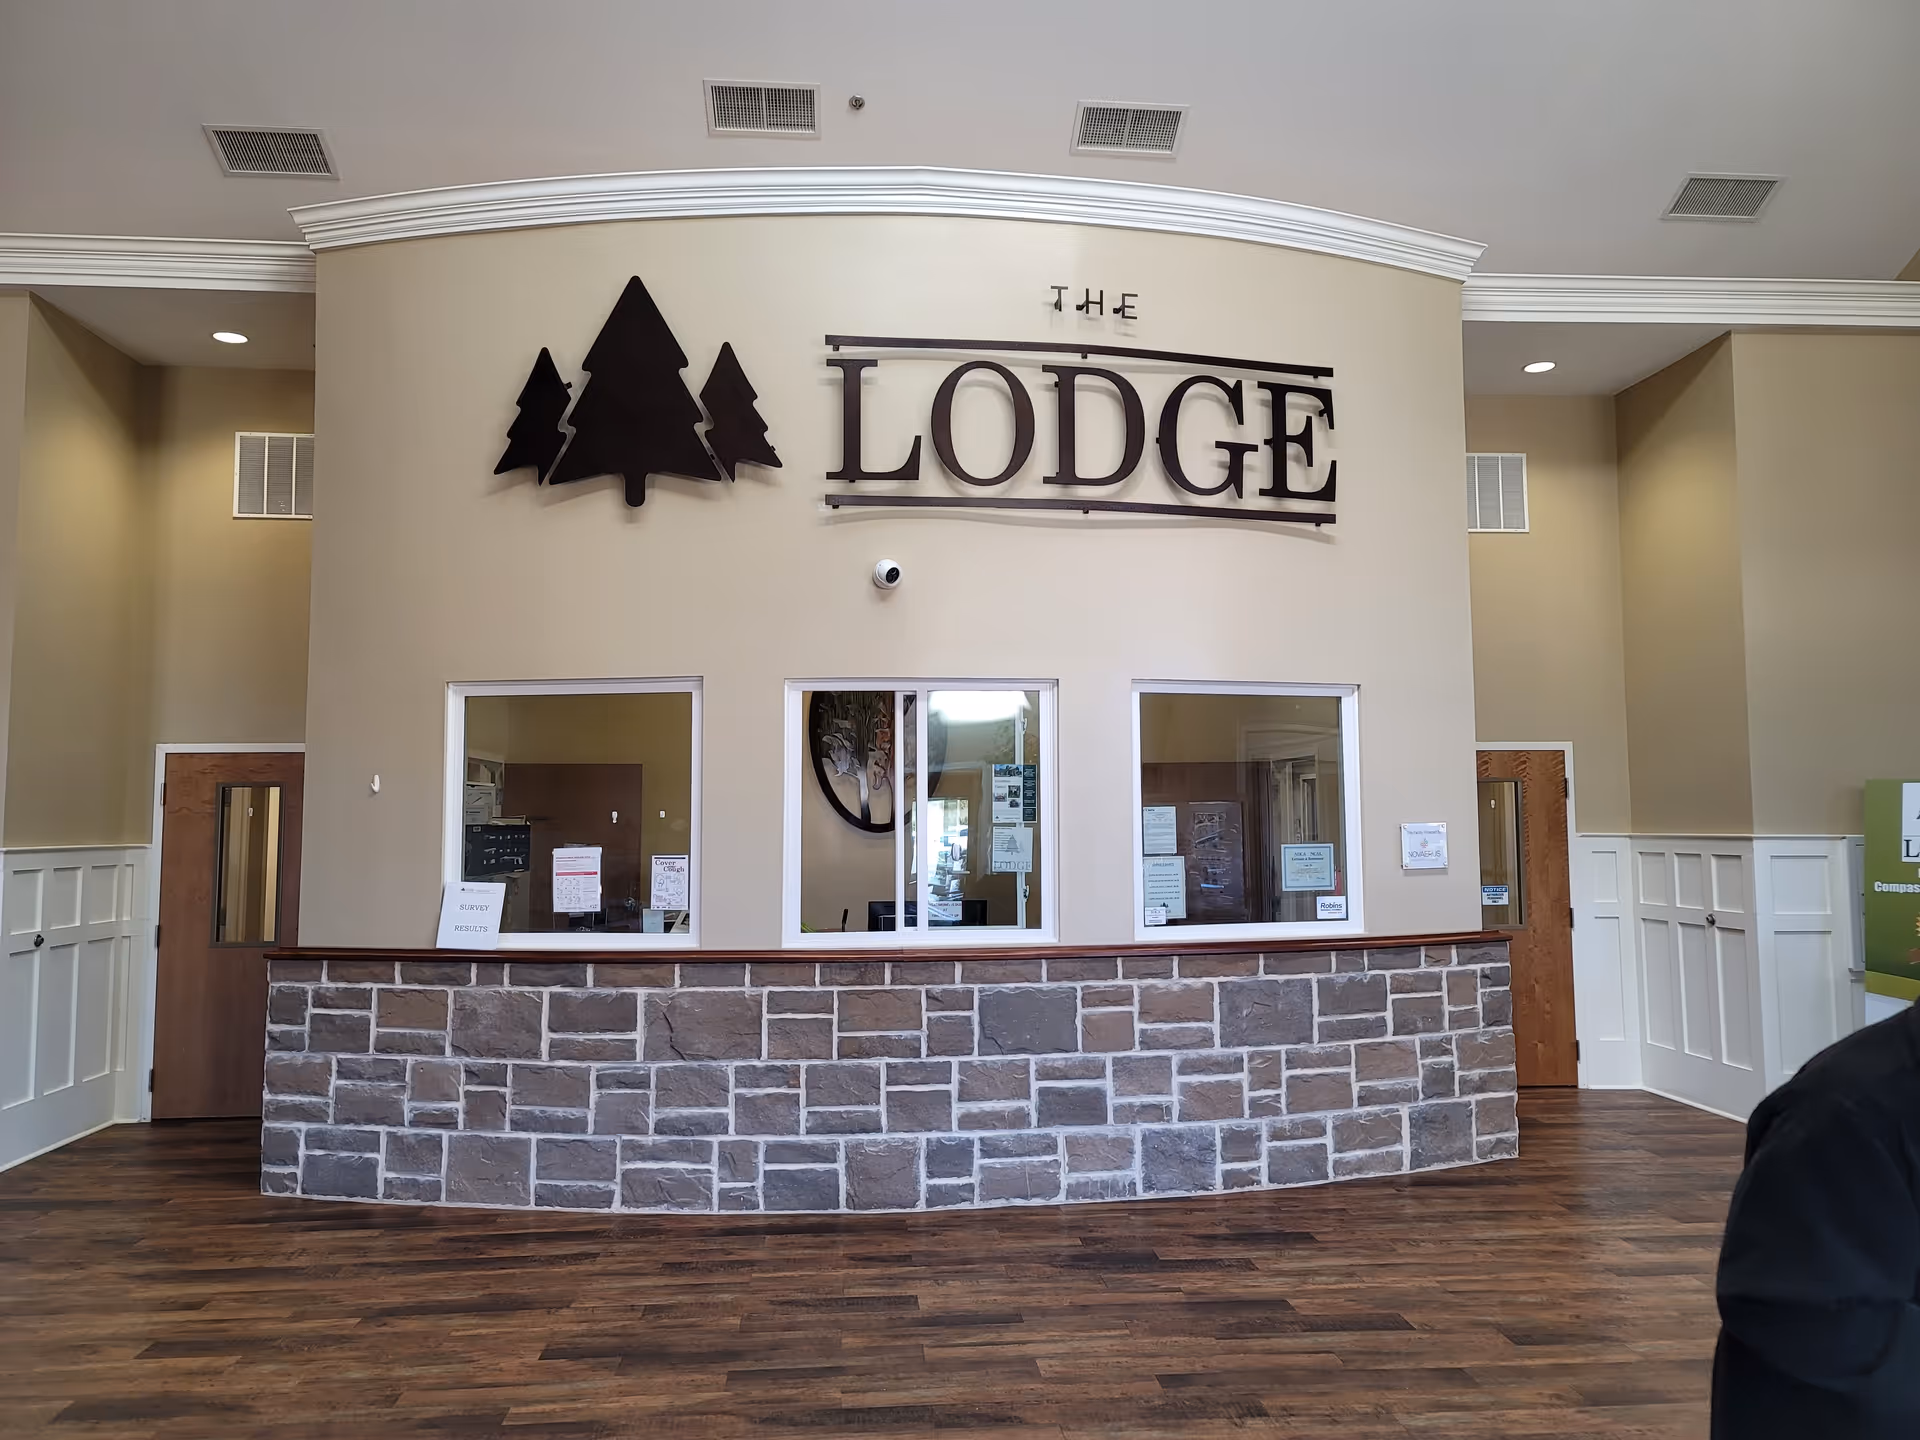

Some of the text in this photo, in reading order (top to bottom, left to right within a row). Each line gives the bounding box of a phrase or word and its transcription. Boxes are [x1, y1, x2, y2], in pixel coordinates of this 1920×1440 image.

[1050, 285, 1138, 320] THE
[826, 358, 1337, 502] LODGE
[663, 865, 685, 873] Cough
